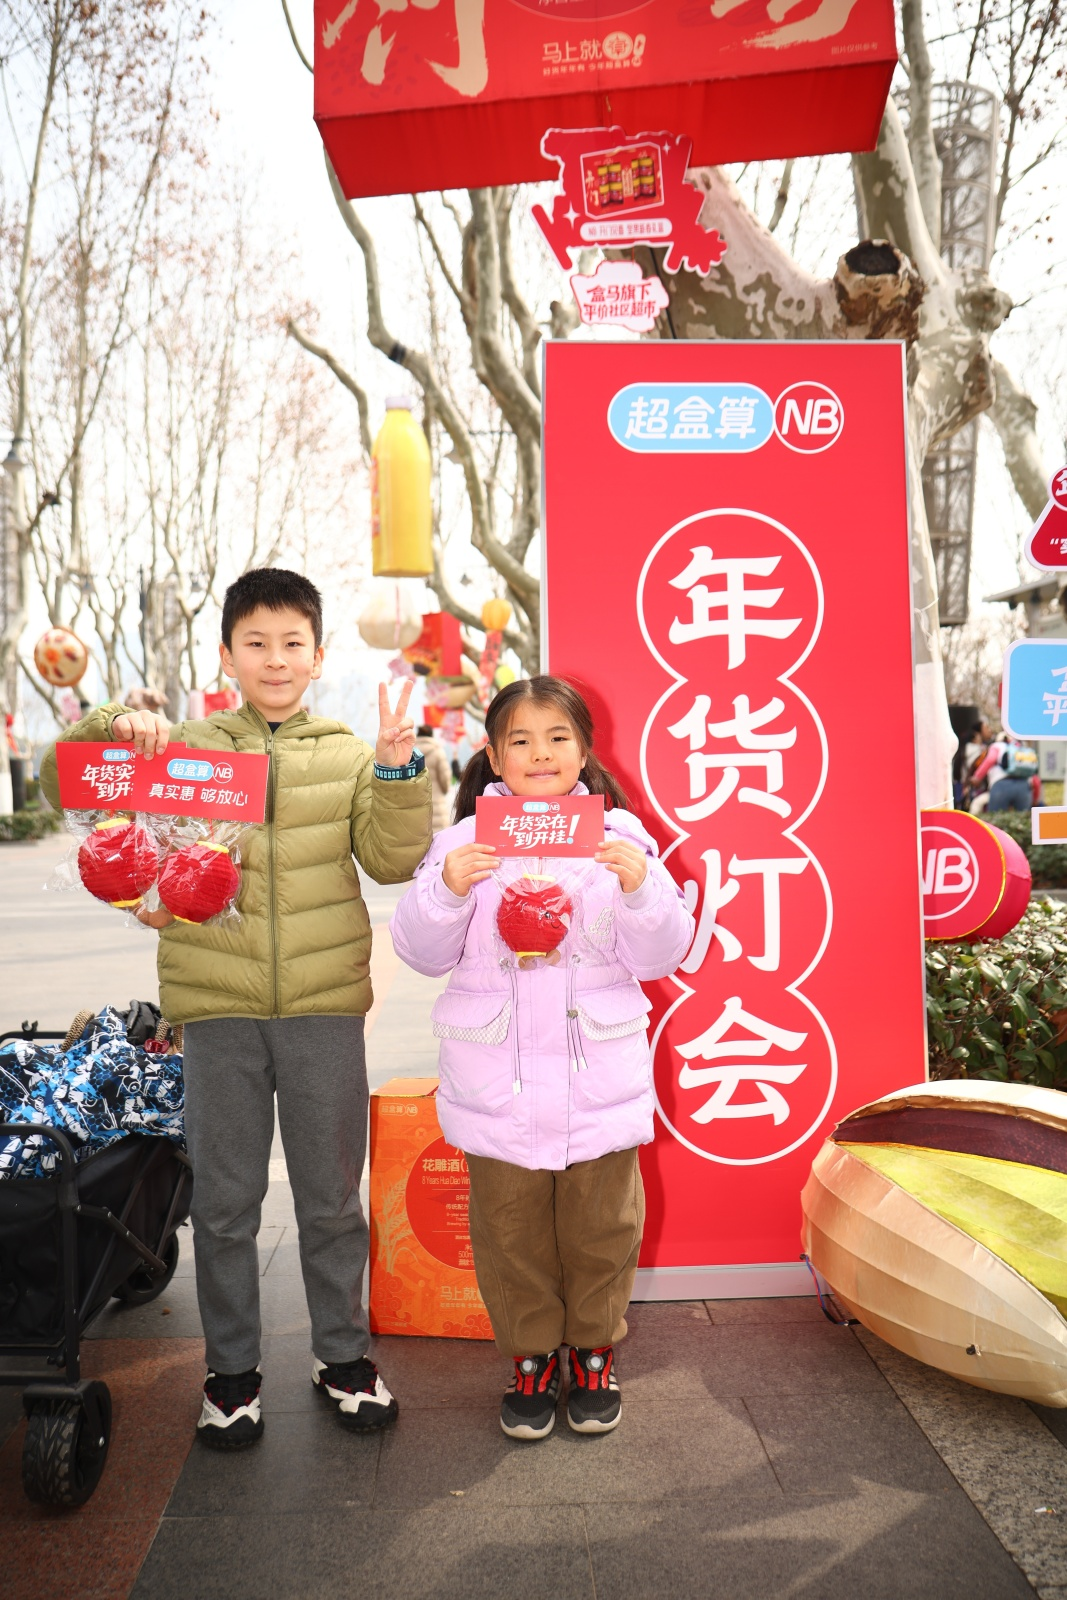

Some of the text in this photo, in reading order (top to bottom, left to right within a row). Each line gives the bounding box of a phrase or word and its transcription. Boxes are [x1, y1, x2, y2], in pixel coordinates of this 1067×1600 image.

[586, 282, 652, 302] 盒马旗下
[583, 301, 656, 321] 平价社区超市
[624, 396, 839, 439] 超盒算 NB
[105, 751, 128, 760] 超盒算
[81, 763, 136, 788] 年货实
[171, 763, 232, 779] 超盒算 NB
[95, 781, 134, 802] 到开
[148, 783, 249, 807] 真实惠 够放心
[550, 804, 560, 812] NB
[499, 814, 568, 837] 年货实在
[422, 1158, 470, 1173] 花雕酒(
[426, 1176, 439, 1185] Years
[440, 1176, 450, 1185] Hua
[461, 1176, 471, 1185] Win
[458, 1250, 474, 1259] 500m
[440, 1285, 480, 1302] 马上就
